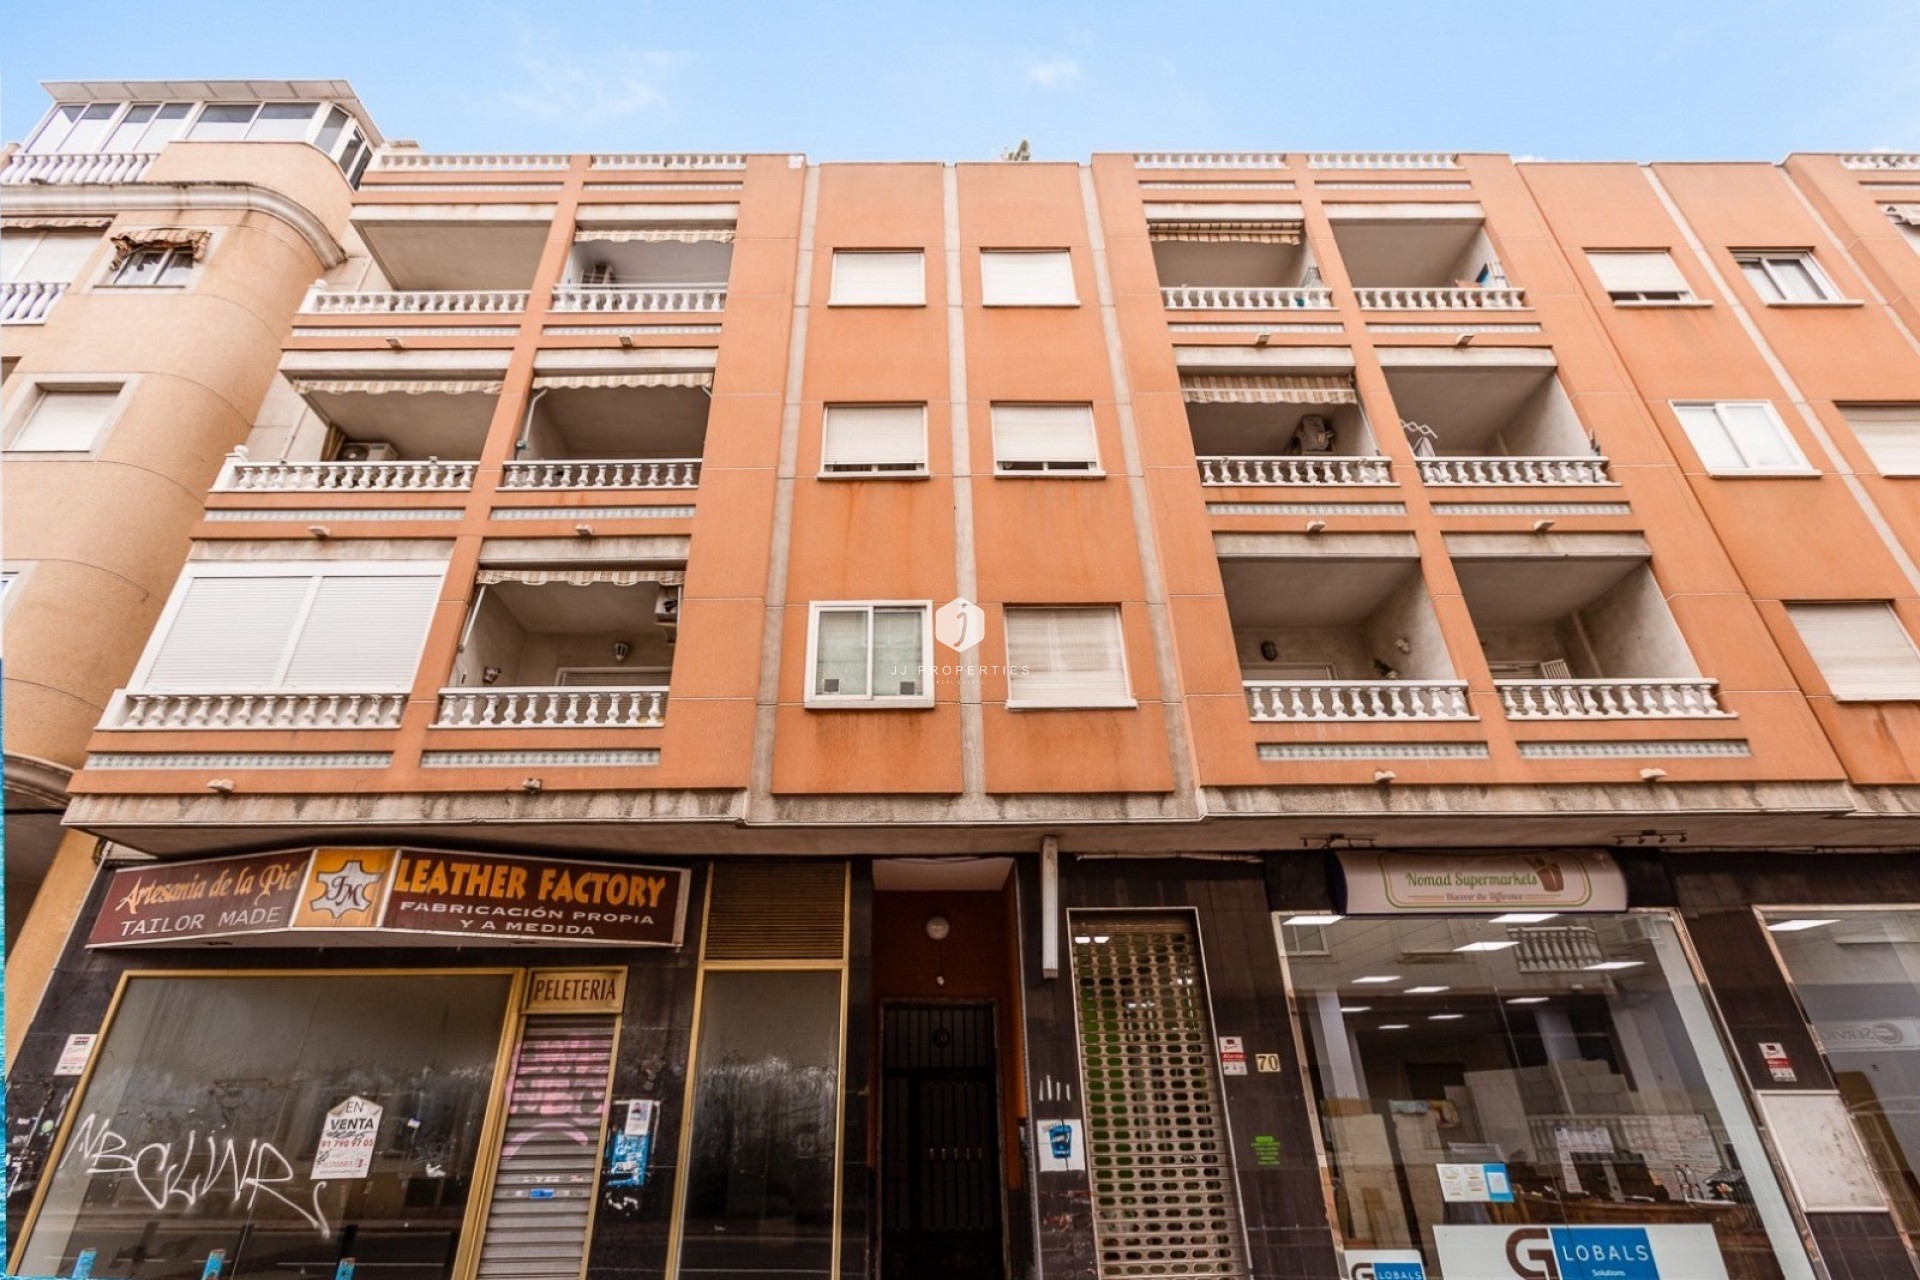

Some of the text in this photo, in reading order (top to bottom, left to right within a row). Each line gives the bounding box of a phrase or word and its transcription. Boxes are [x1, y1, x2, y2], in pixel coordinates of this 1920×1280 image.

[209, 868, 231, 898] de
[234, 866, 254, 895] la
[394, 859, 667, 908] LEATHER FACTORY
[1405, 871, 1538, 889] Nomad Supermarkets
[121, 906, 283, 936] TAILOR MADE
[400, 901, 655, 925] FABRICACIÓN PROPIA
[460, 919, 596, 935] Y A MEDIDA
[534, 978, 617, 1001] PELETERIA
[1257, 1055, 1279, 1071] 70
[345, 1100, 365, 1113] EN
[330, 1117, 374, 1130] VENTA
[321, 1140, 331, 1148] 91
[334, 1139, 350, 1148] 790
[351, 1139, 361, 1148] 97
[1591, 1268, 1627, 1277] Solutions
